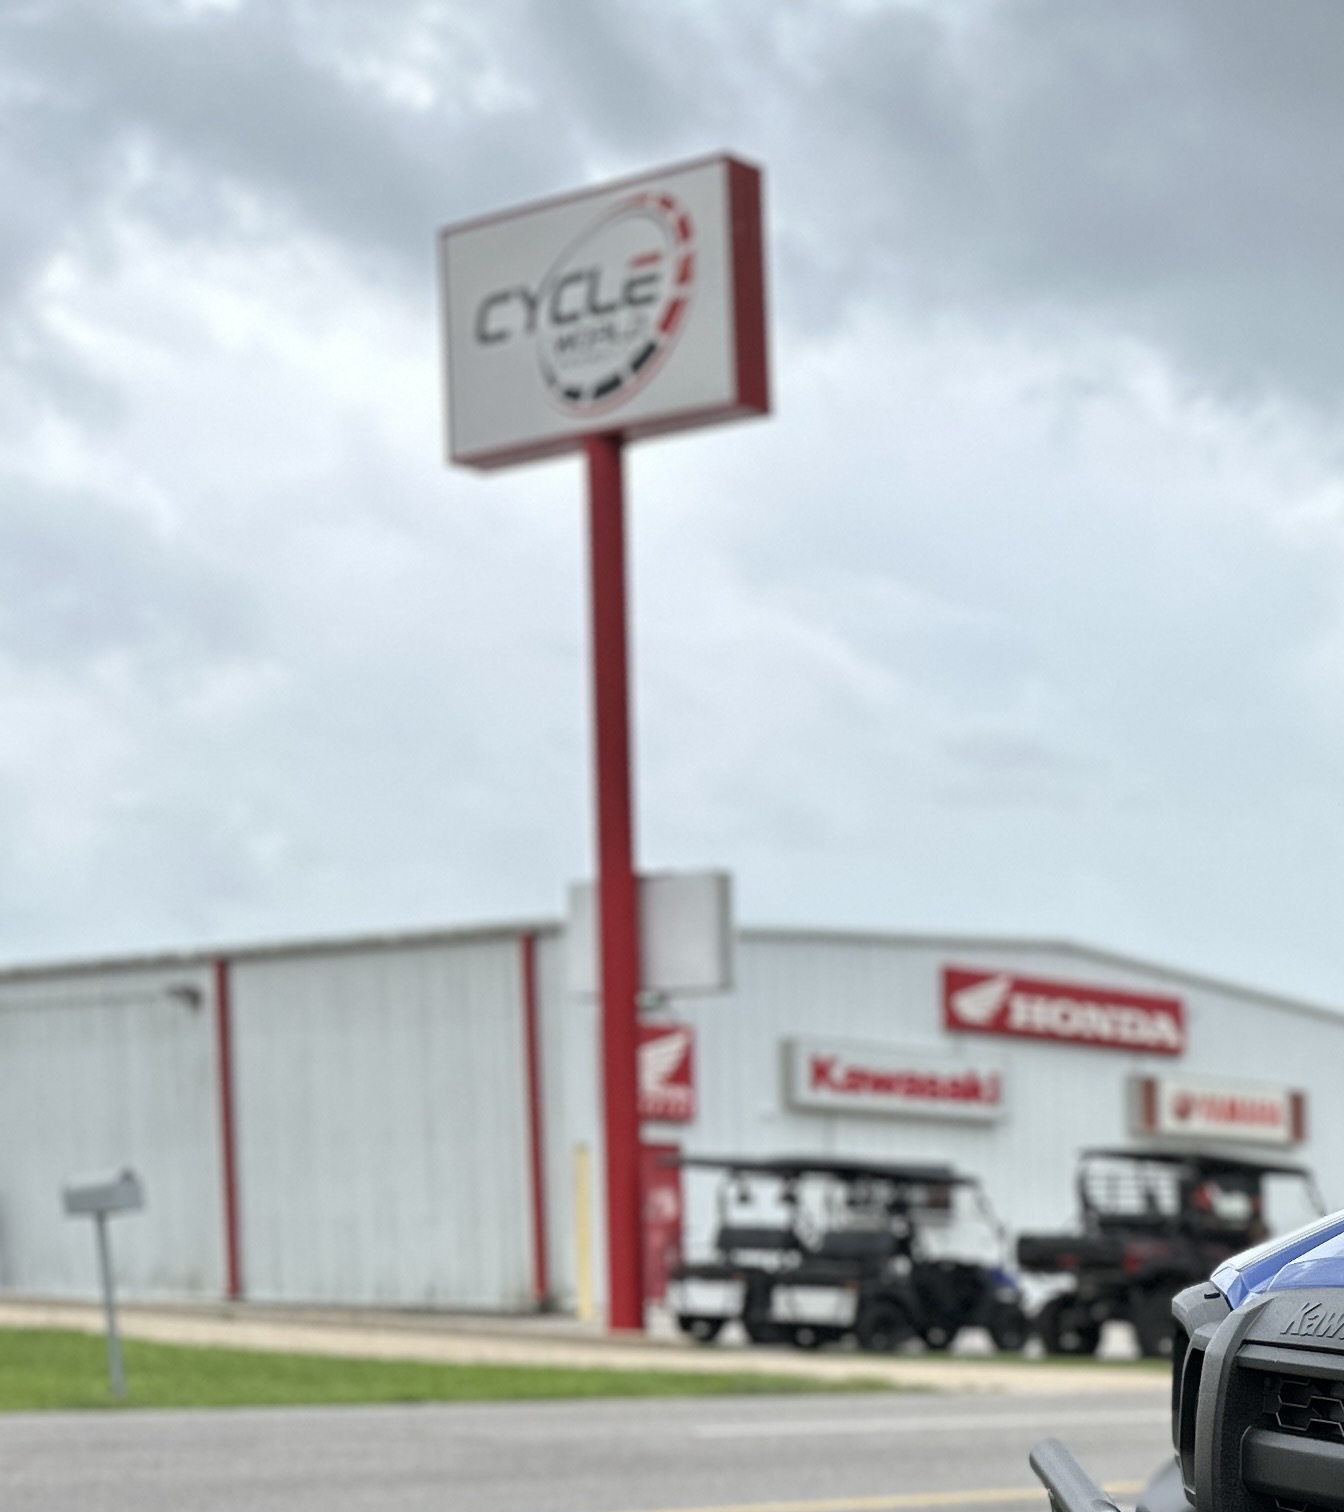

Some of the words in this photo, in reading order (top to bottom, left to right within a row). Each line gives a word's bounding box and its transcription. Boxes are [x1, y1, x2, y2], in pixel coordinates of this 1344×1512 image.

[474, 252, 661, 345] CYCLE
[1005, 993, 1181, 1048] HONDA
[809, 1055, 1002, 1106] Kawasaki
